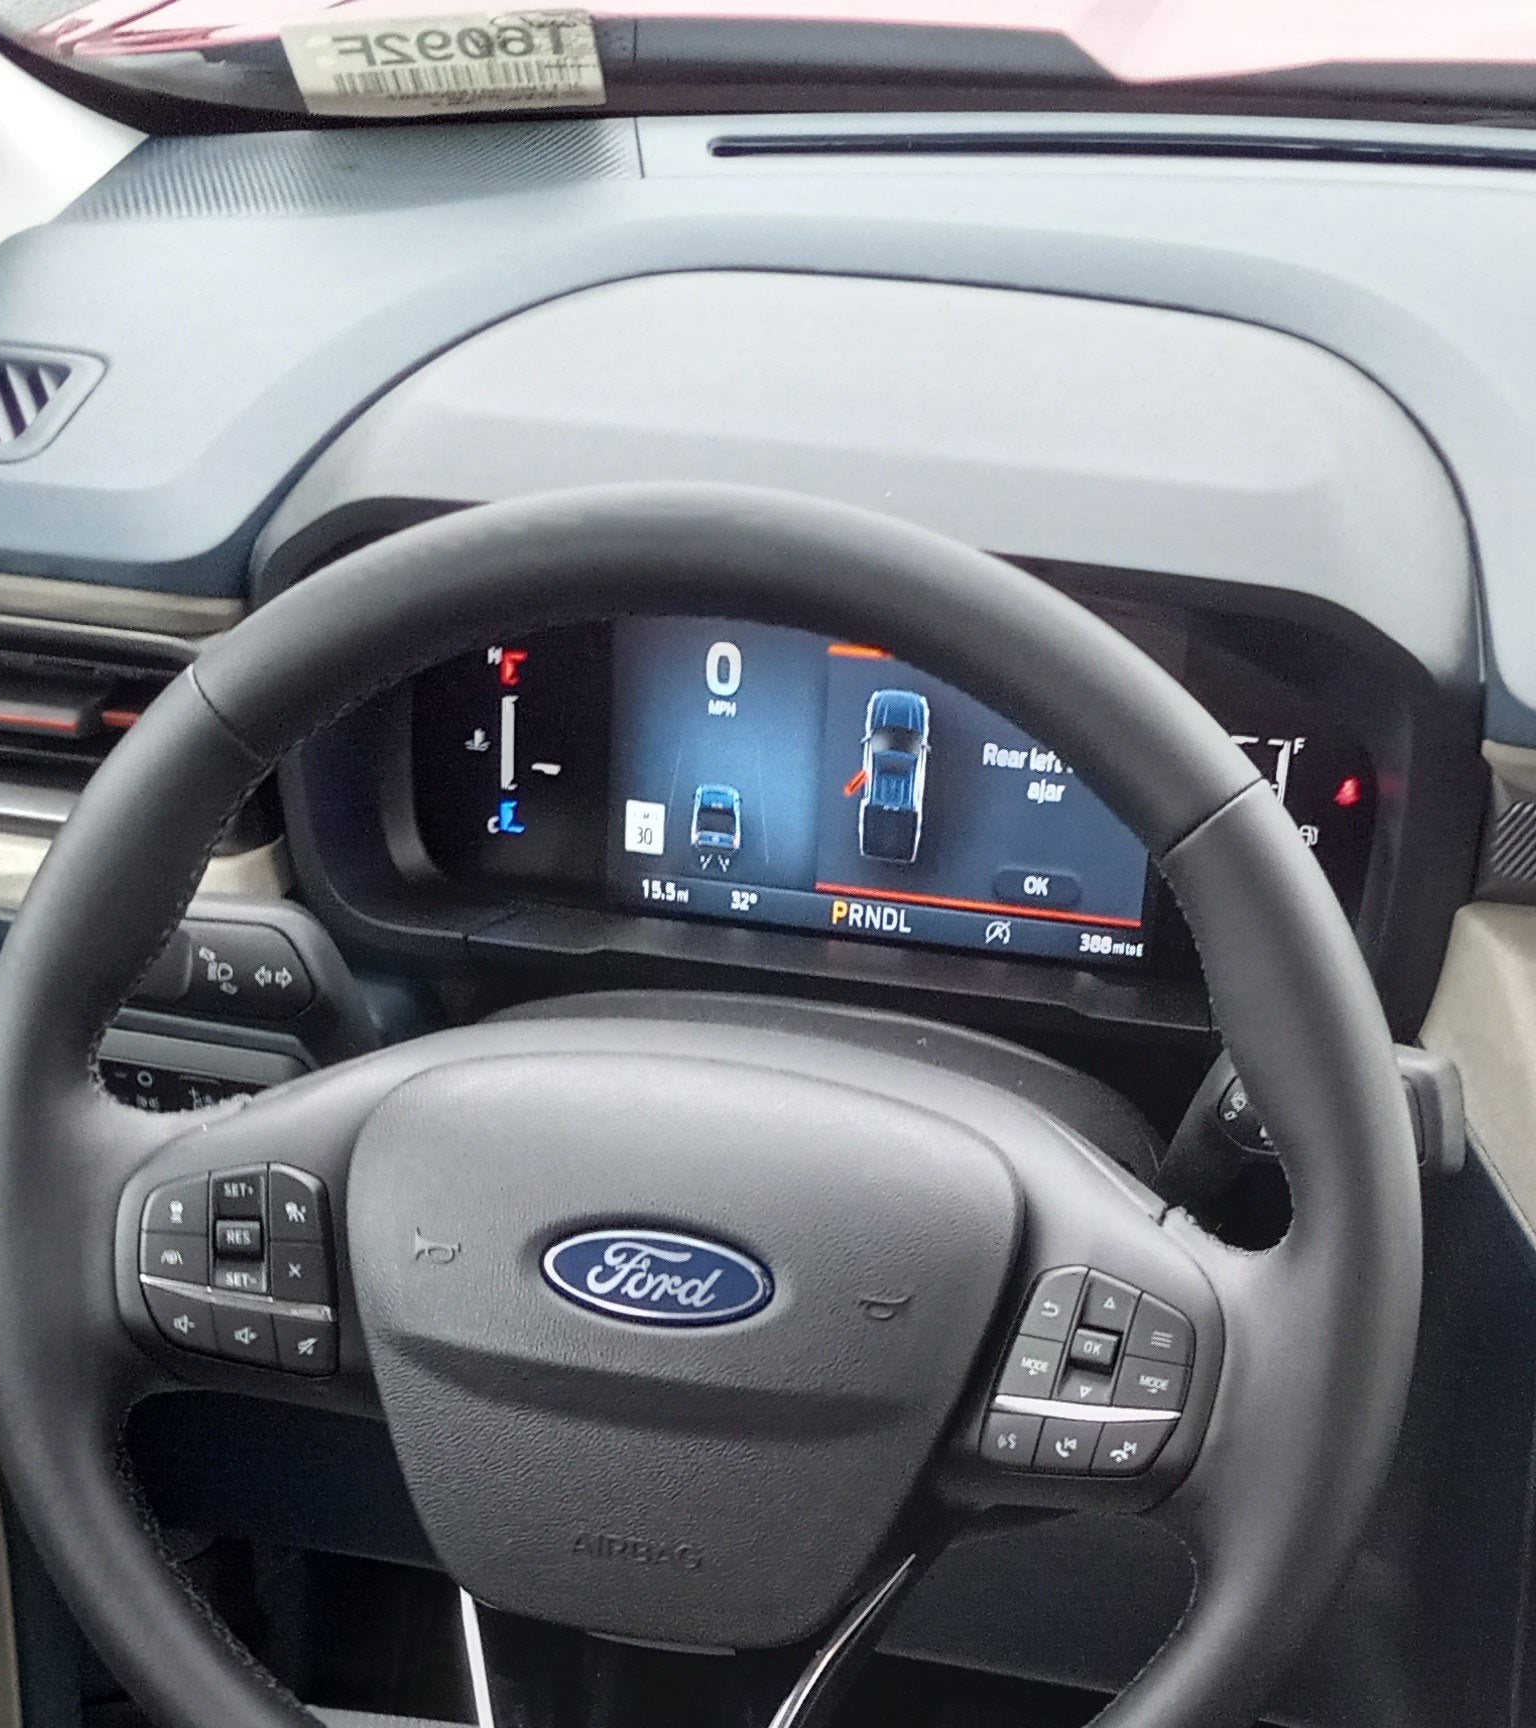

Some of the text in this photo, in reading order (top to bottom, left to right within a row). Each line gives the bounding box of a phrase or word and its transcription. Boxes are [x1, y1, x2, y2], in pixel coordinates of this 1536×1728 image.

[705, 641, 742, 697] 0
[707, 699, 737, 717] MPH
[981, 741, 1028, 769] Rear
[1292, 737, 1306, 755] F
[1026, 778, 1066, 804] ajar
[636, 826, 653, 846] 30
[1023, 875, 1050, 897] OK
[831, 900, 912, 934] PRNDL
[225, 1228, 252, 1246] RES
[586, 1241, 717, 1311] Ford
[1083, 1340, 1103, 1357] OK
[1020, 1356, 1050, 1374] MODE
[1138, 1374, 1171, 1392] MODE
[573, 1531, 705, 1572] AIRBAG
